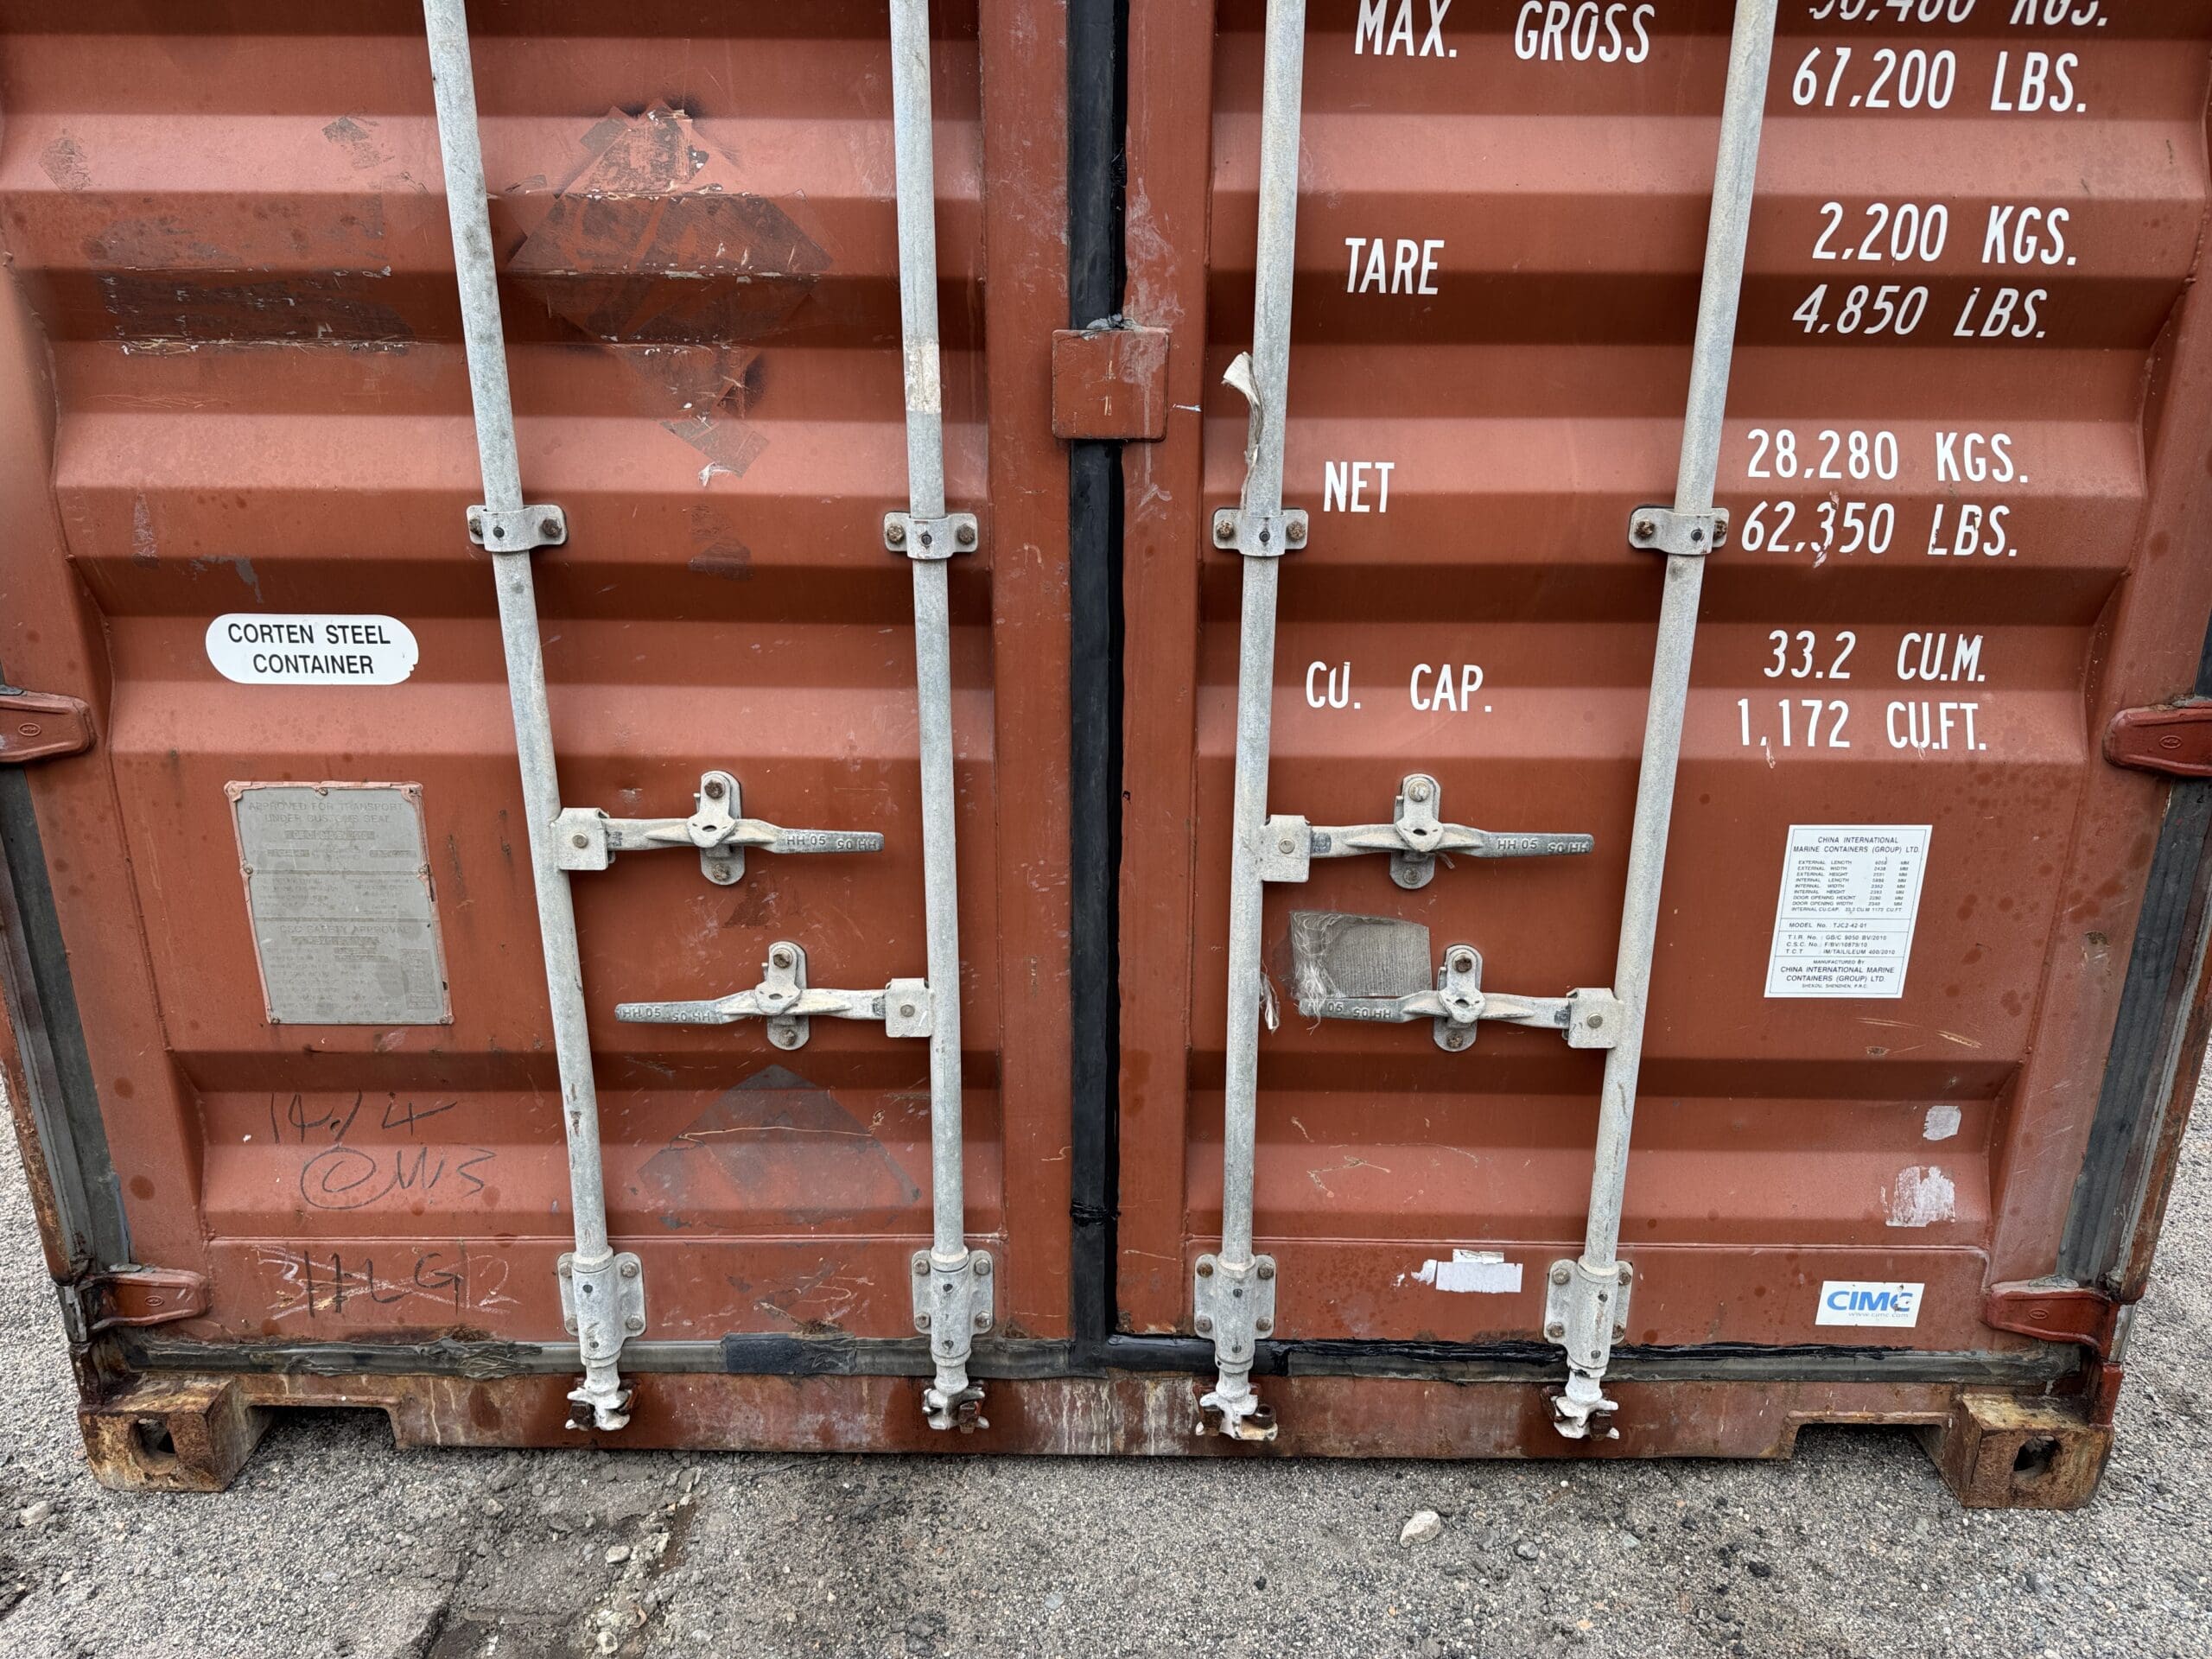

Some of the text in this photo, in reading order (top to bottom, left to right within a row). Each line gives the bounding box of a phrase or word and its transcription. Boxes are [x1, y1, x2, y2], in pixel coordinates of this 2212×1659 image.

[1355, 0, 1654, 63] MAX. GROSS
[1793, 48, 2086, 112] 67,200 LBS.
[1345, 202, 2076, 294] TARE 2,200 KGS.
[1793, 284, 2047, 337] 4,850 LBS.
[1324, 429, 2031, 512] NET 28,280 KGS.
[1742, 499, 2017, 557] 62,350 LBS.
[228, 623, 391, 645] CORTEN STEEL
[253, 654, 374, 674] CONTAINER
[1306, 630, 1985, 715] CU. CAP. 33.2 CU.M.
[1738, 698, 1987, 752] 1,172 CU.FT.
[1827, 1290, 1913, 1313] CIMC
